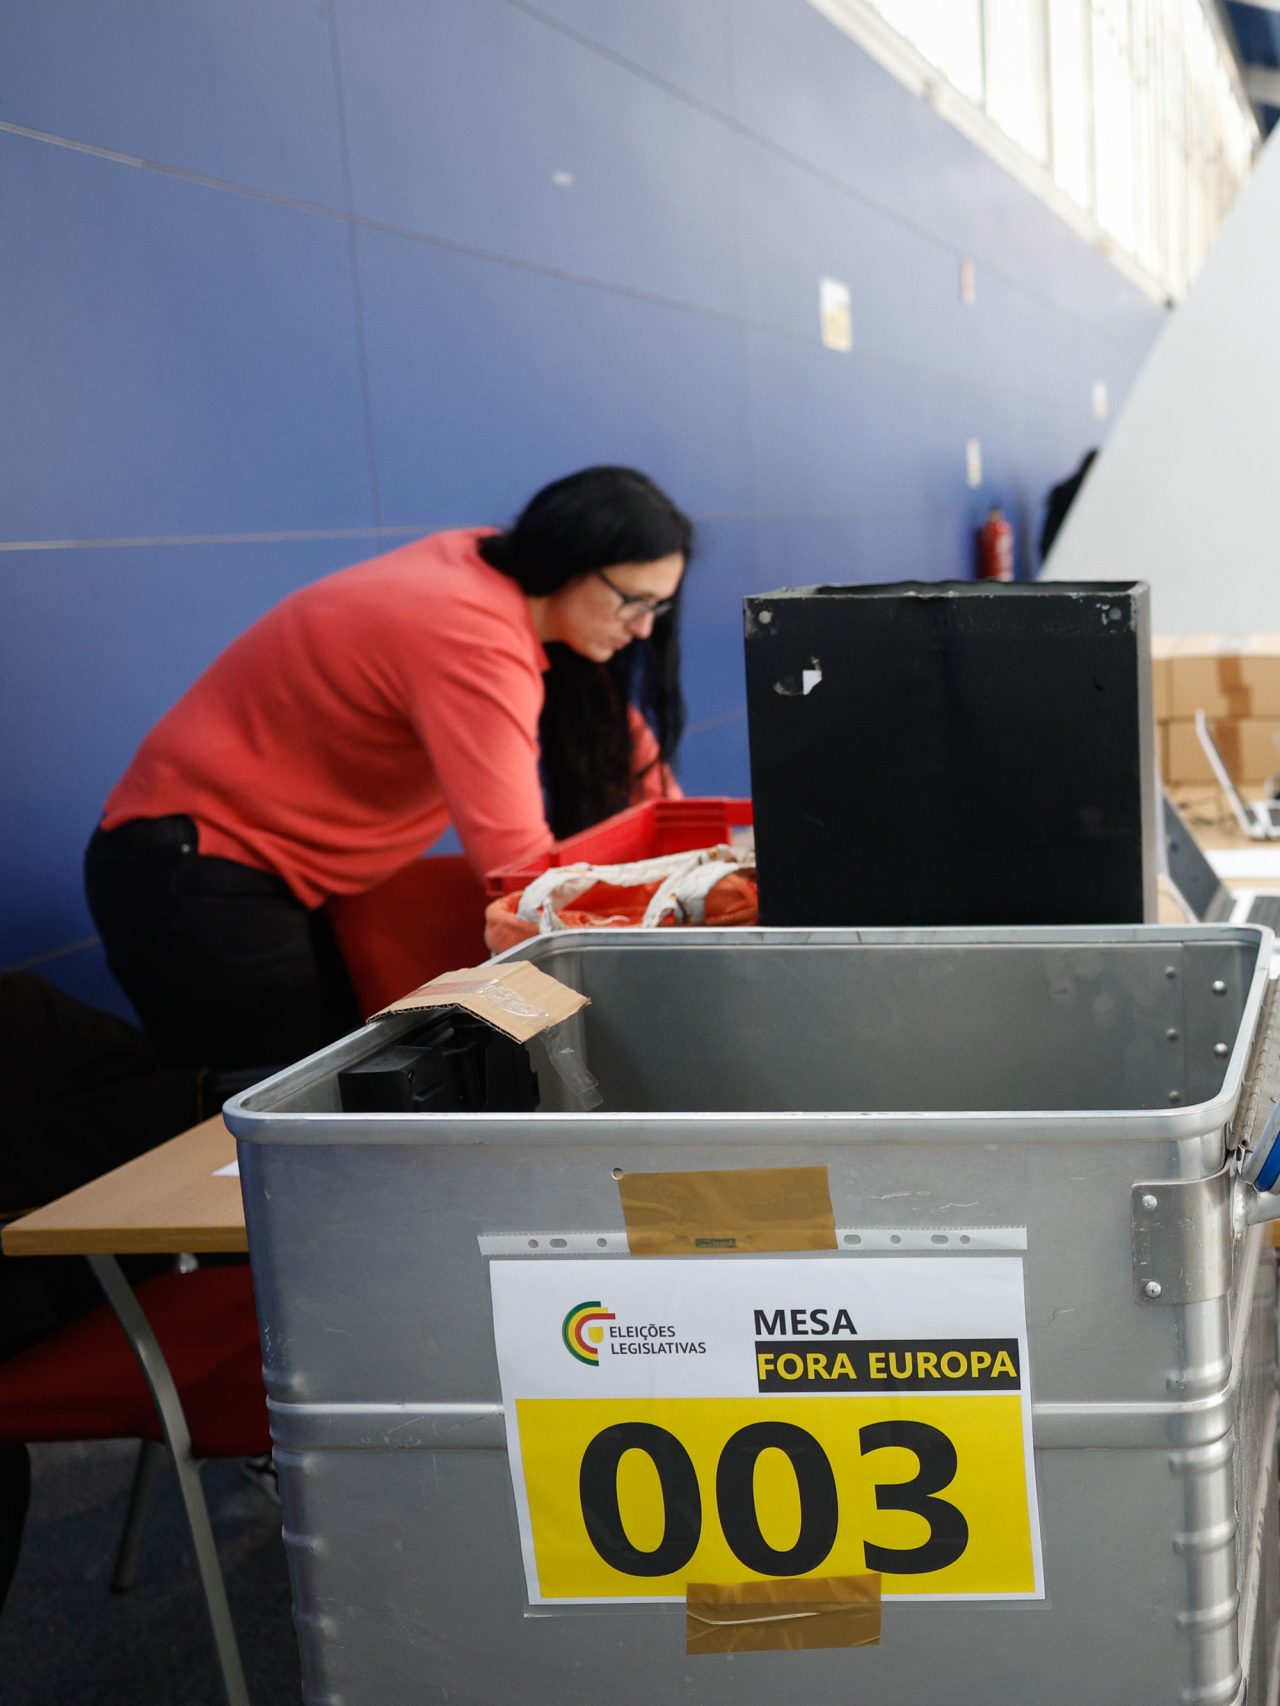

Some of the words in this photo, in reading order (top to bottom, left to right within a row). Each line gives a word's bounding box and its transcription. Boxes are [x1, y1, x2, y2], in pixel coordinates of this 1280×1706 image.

[609, 1323, 676, 1341] ELEIÇÕES
[753, 1309, 858, 1336] MESA
[611, 1342, 707, 1355] LEGISLATIVAS
[757, 1352, 858, 1381] FORA
[868, 1350, 1018, 1380] EUROPA
[578, 1419, 971, 1578] 003
